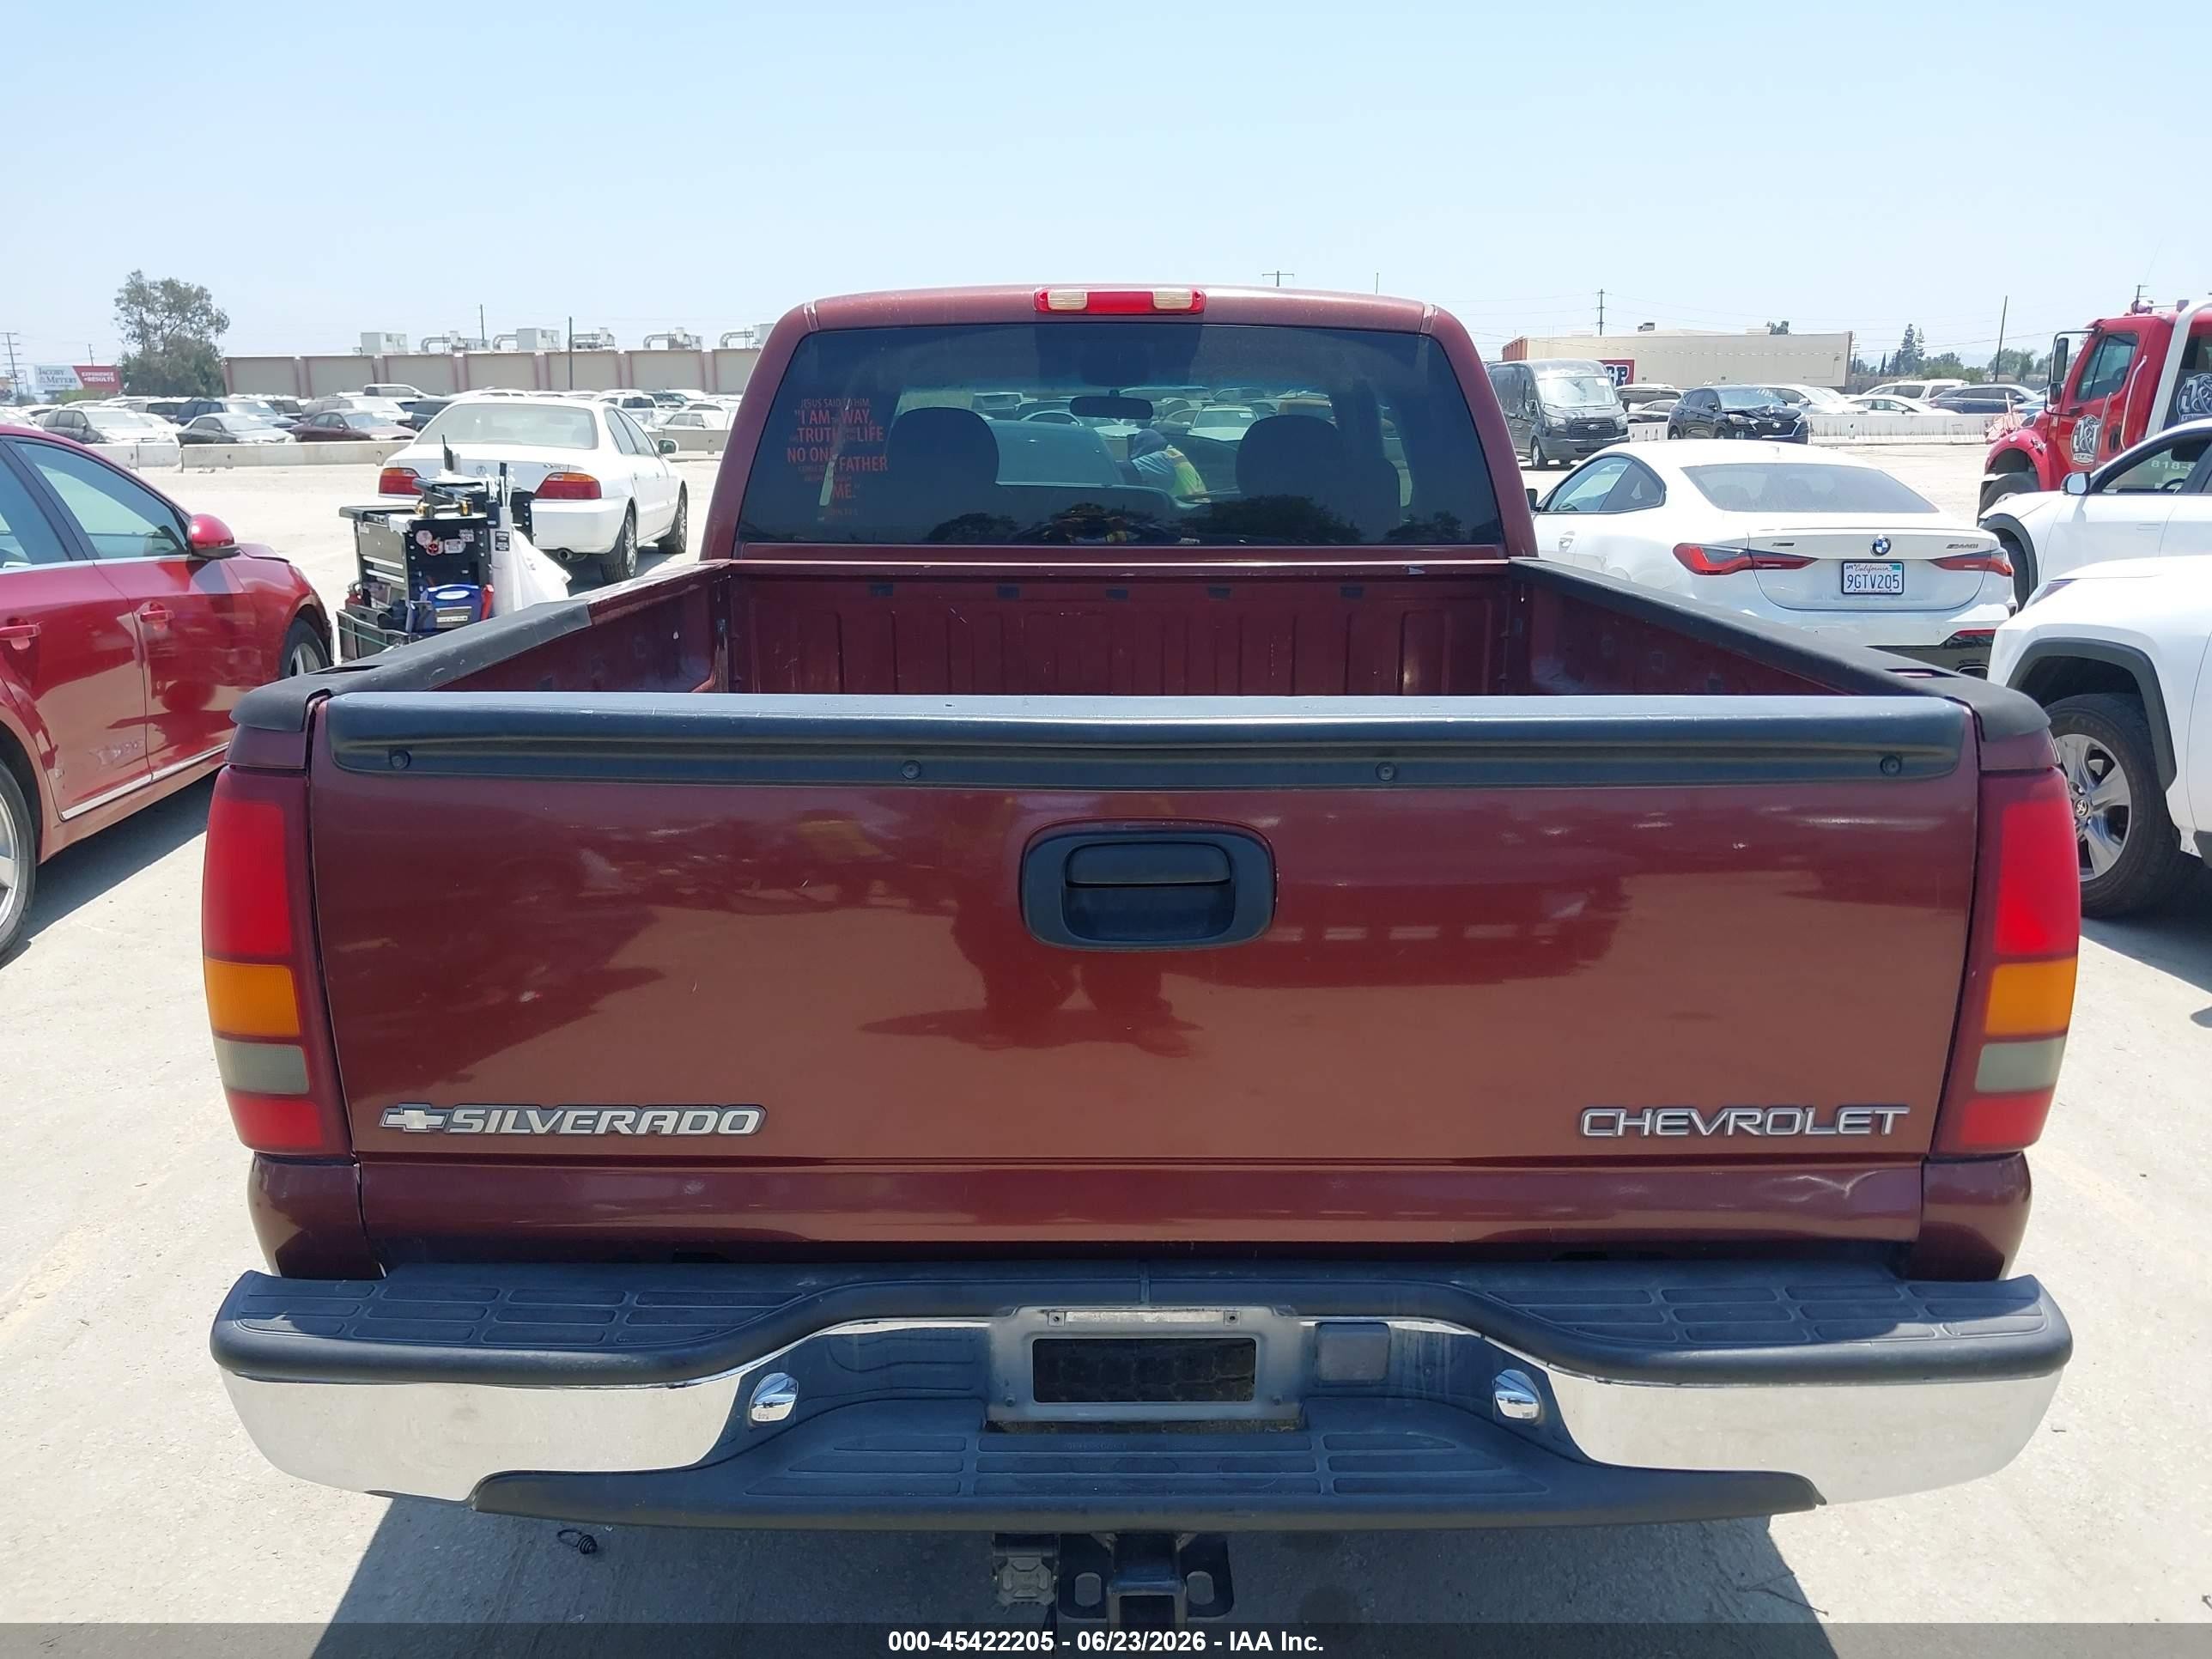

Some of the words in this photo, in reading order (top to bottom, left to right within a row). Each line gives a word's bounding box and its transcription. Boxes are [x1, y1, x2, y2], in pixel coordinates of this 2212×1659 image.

[810, 410, 830, 424] AM
[857, 426, 884, 441] LIFE
[787, 447, 805, 463] NO
[839, 457, 888, 471] FATHER
[1855, 564, 1892, 574] California
[1847, 574, 1899, 589] 9GTV205
[447, 1108, 763, 1134] SILVERADO
[1581, 1104, 1910, 1136] CHEVROLET
